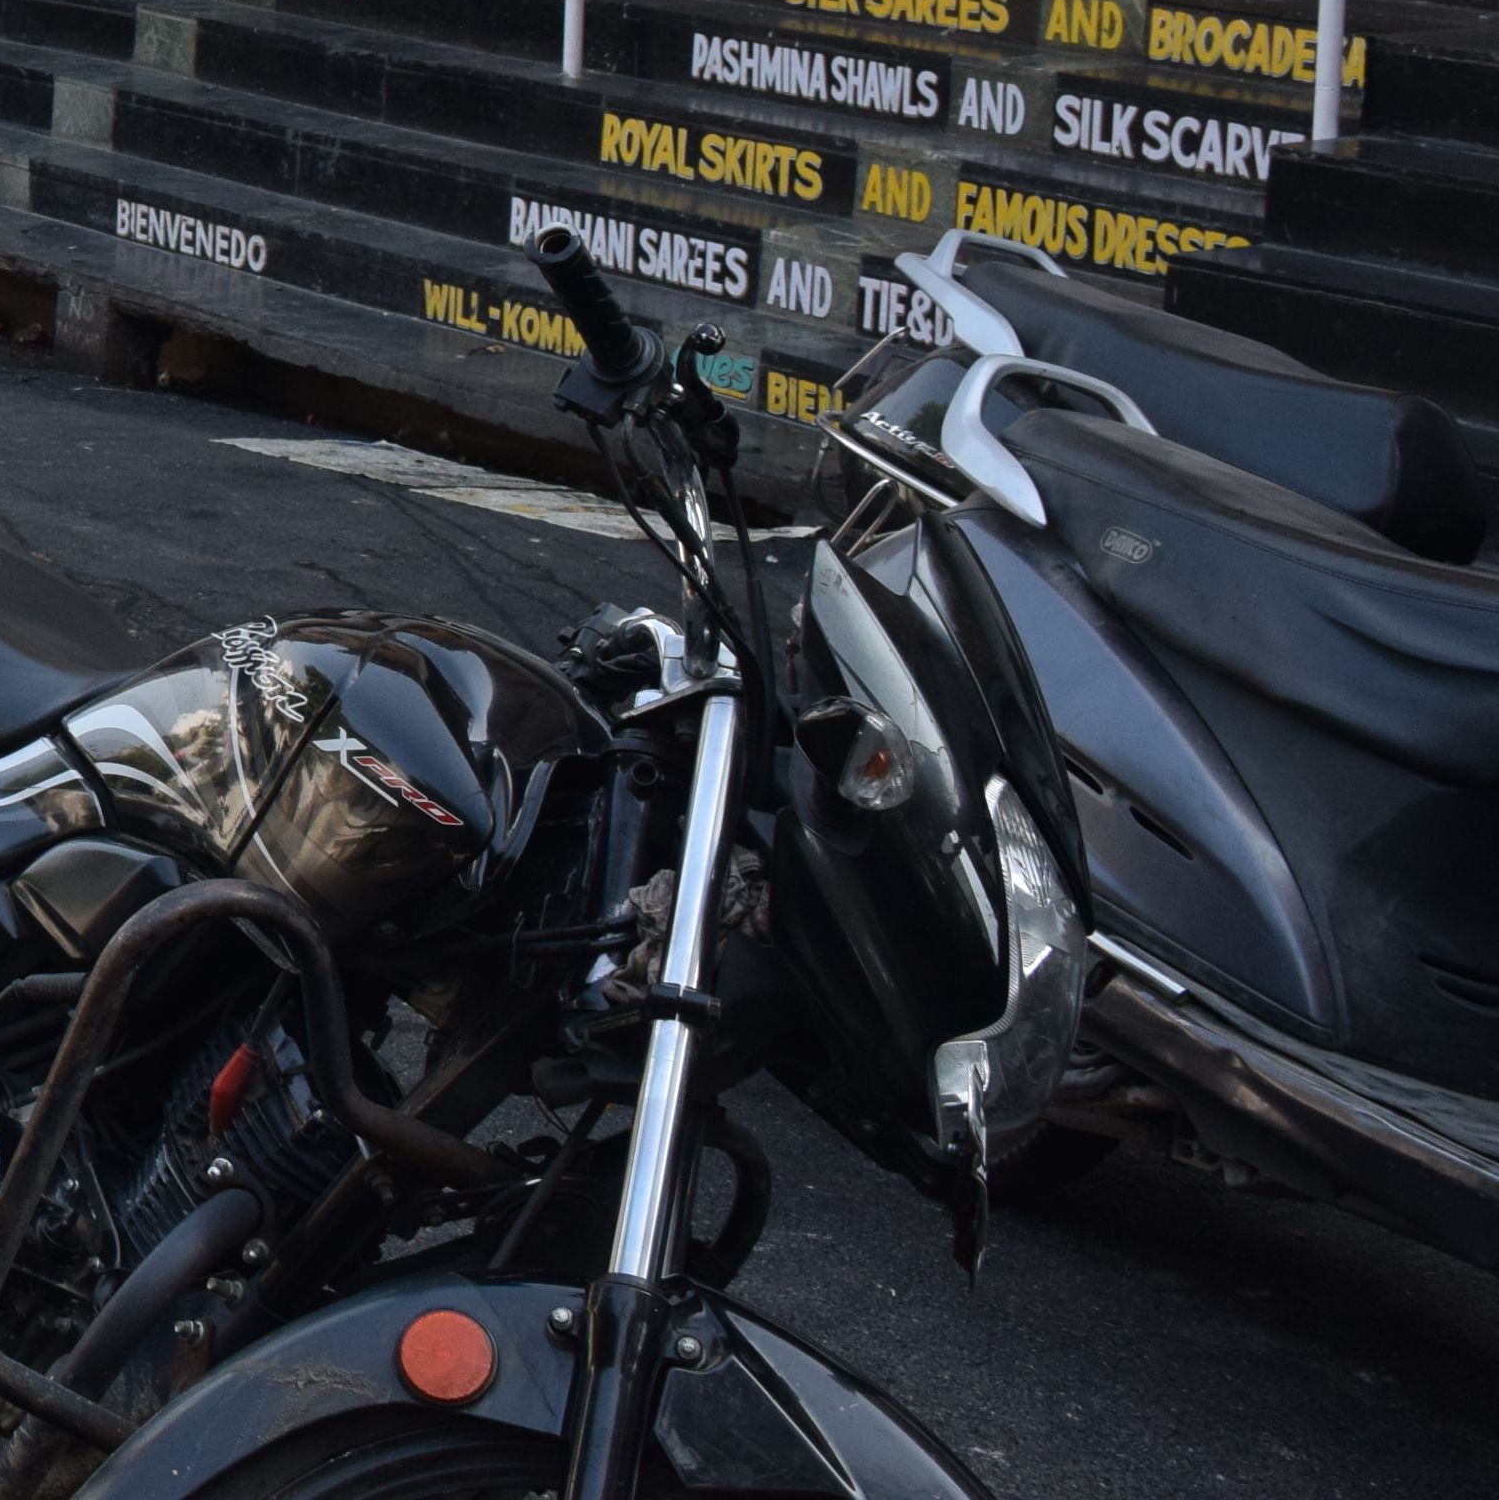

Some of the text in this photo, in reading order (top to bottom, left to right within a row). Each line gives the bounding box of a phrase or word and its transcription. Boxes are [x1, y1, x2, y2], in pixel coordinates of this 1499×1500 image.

[692, 32, 825, 103] PASHMINA
[831, 55, 940, 120] SHAWLS
[958, 78, 1025, 137] AND
[1053, 94, 1137, 159] SILK
[116, 198, 267, 273] BIENVENEDO
[601, 112, 1252, 277] ROYAL SKIRTS AND FAMOUS DRESS
[638, 226, 750, 301] SAREES
[767, 257, 833, 318] AND
